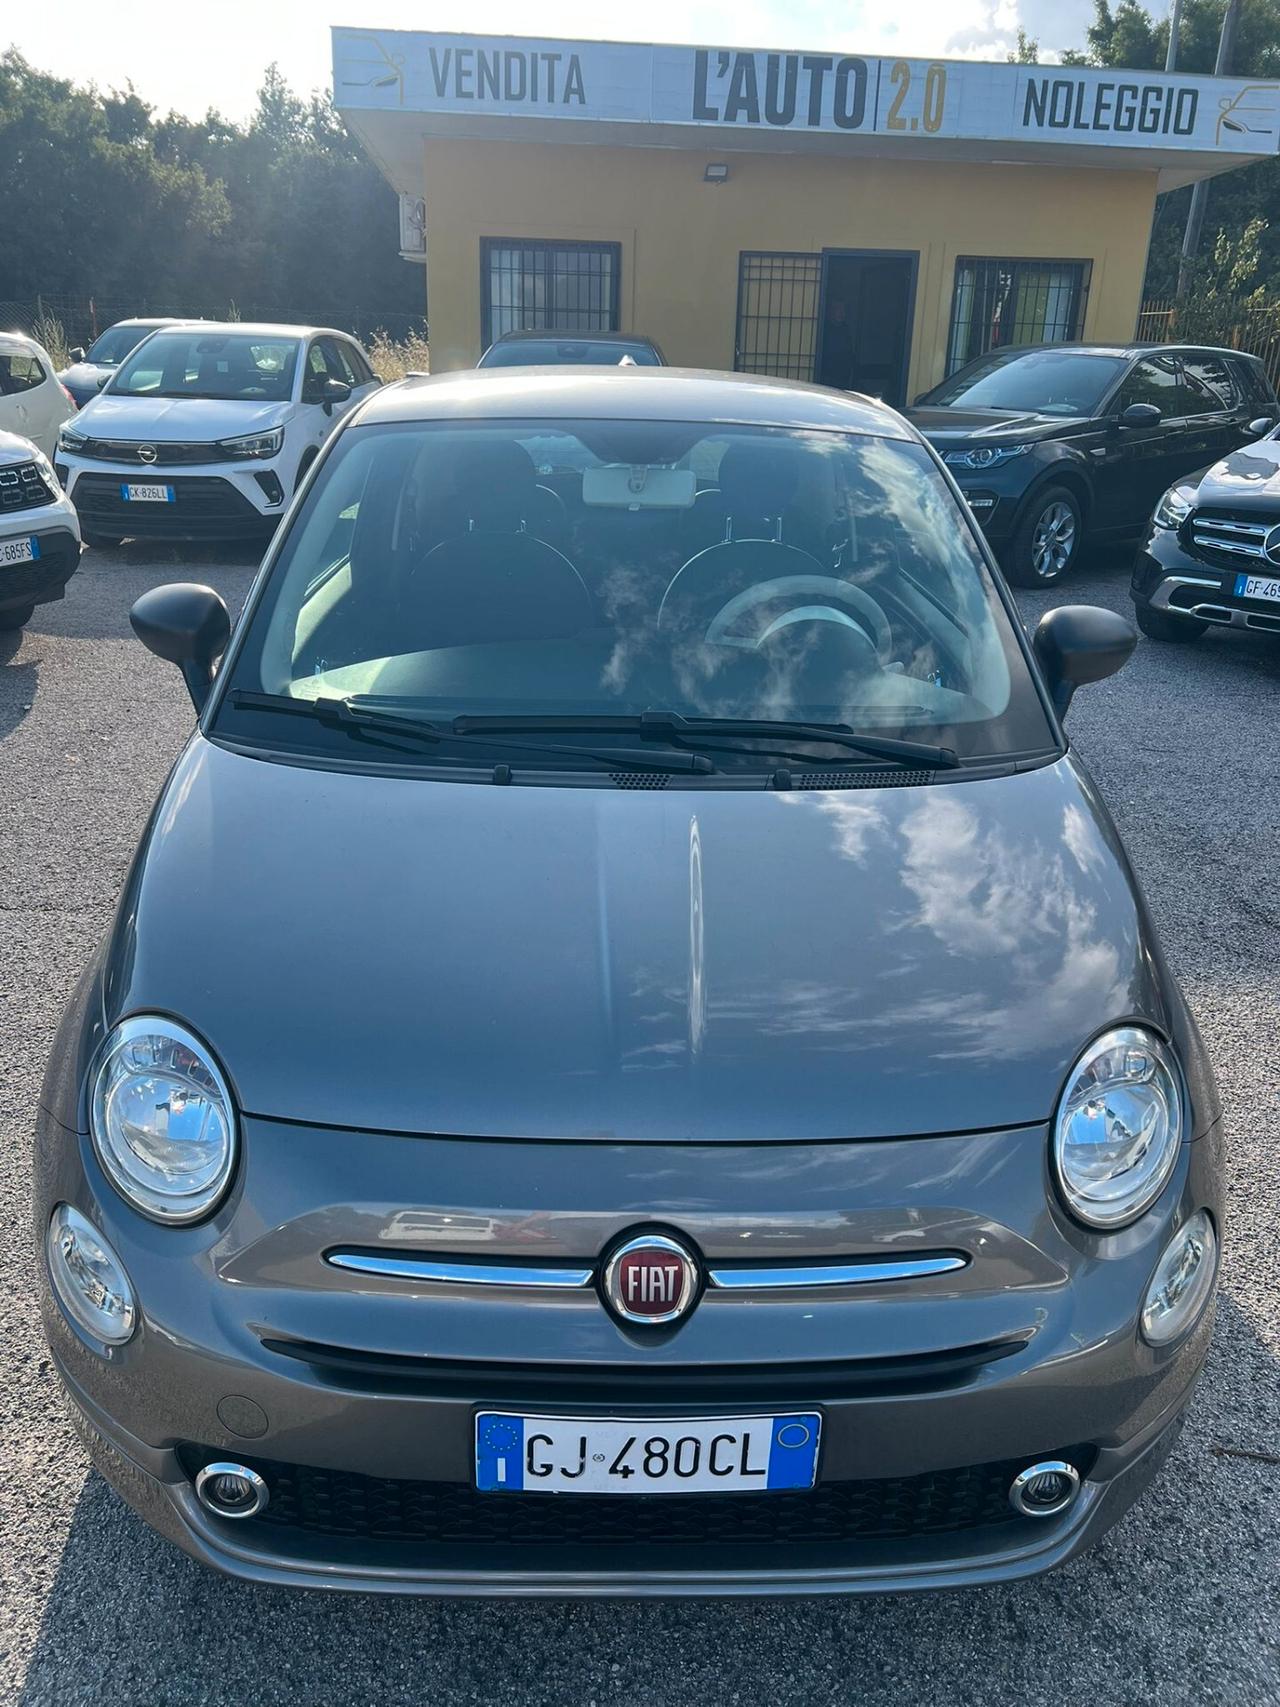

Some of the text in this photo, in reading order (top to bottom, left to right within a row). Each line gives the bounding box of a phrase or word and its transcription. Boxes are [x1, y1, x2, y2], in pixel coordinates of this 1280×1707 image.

[428, 47, 586, 104] VENDITA
[692, 50, 947, 133] L'AUTO 2.0
[1022, 78, 1199, 135] NOLEGGIO
[628, 1265, 679, 1302] FIAT
